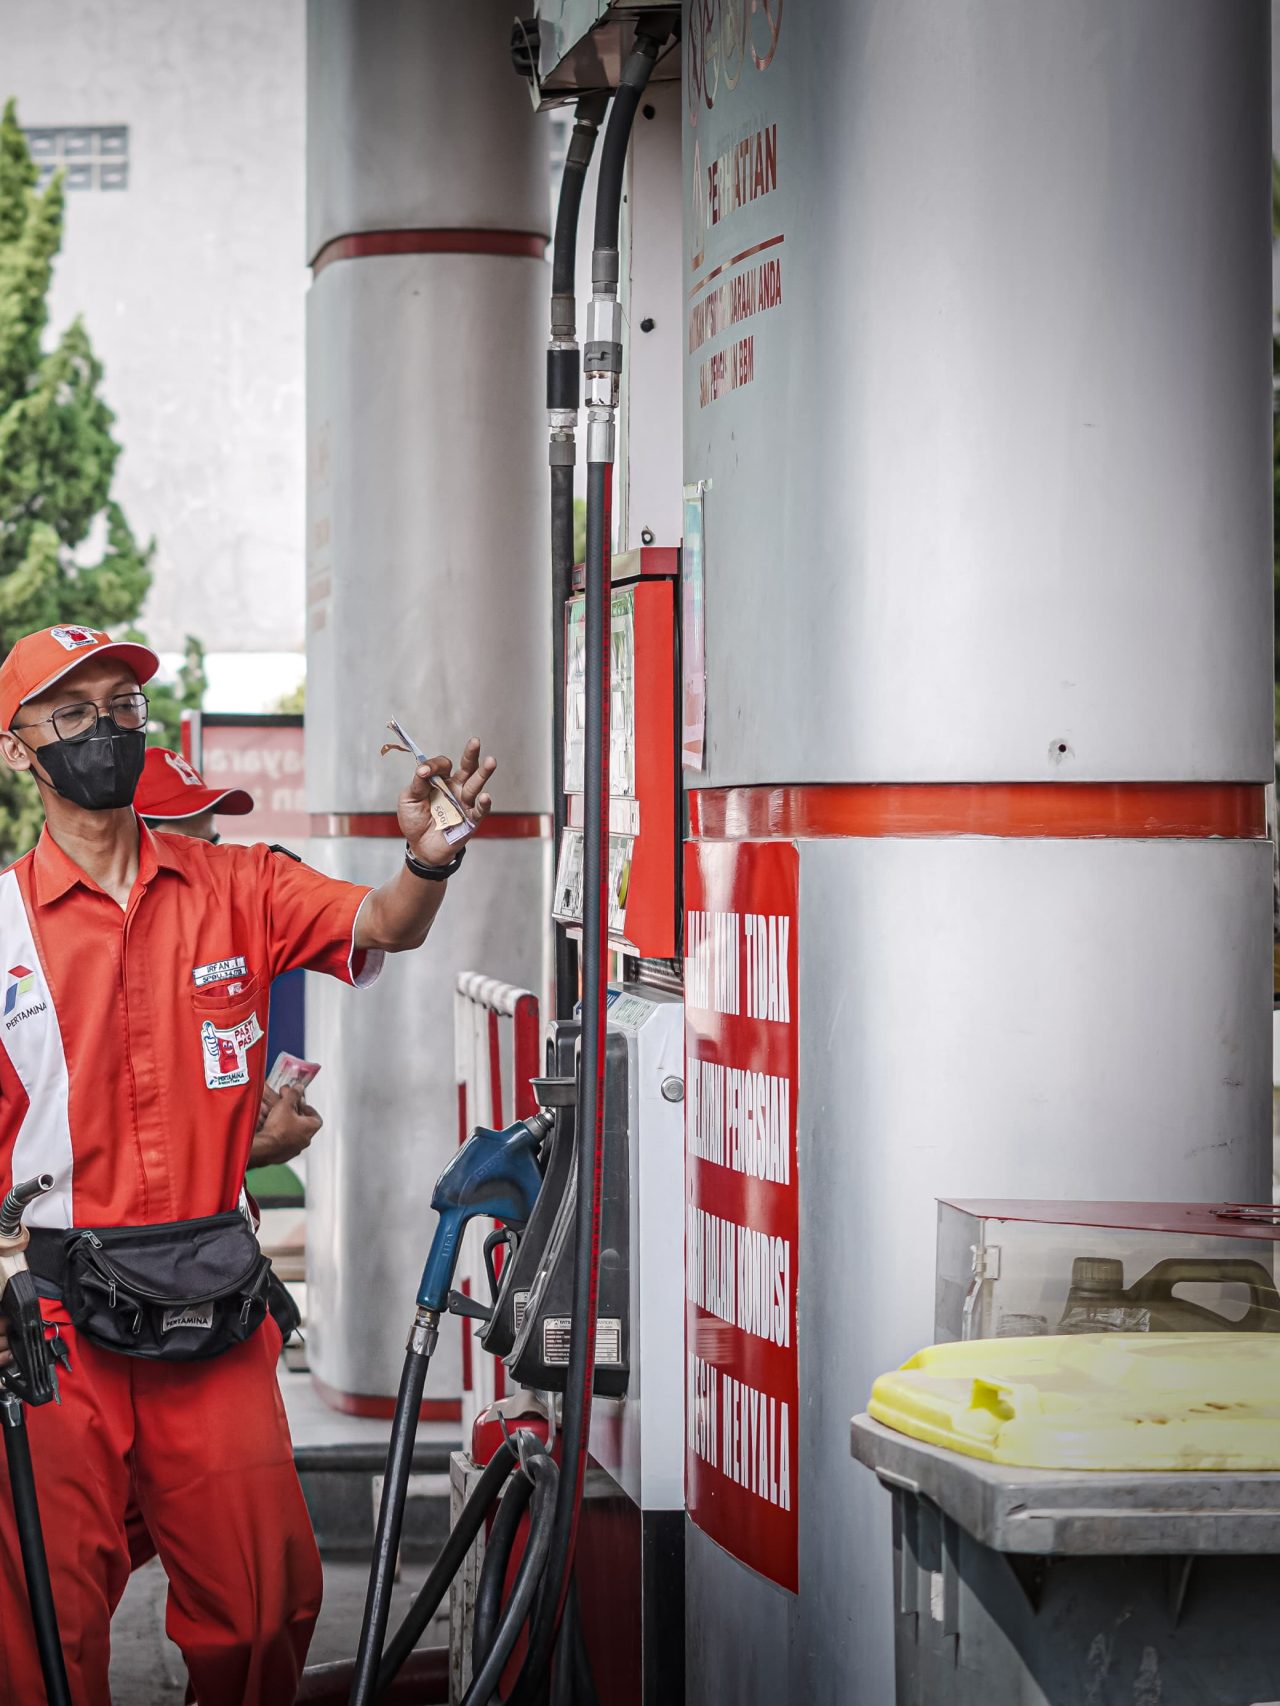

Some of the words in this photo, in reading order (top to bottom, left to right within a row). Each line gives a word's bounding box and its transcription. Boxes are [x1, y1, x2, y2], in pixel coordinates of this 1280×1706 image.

[707, 123, 777, 229] PERHATIAN
[758, 258, 782, 312] ANDA
[739, 334, 754, 387] BBM
[5, 1001, 48, 1031] PERTAMINA
[745, 913, 790, 1024] TIDAK
[688, 1057, 724, 1167] MELAYANI
[726, 1066, 790, 1186] PENGISIAN
[166, 1317, 208, 1327] PERTAMINA
[688, 1203, 704, 1309] BBM
[705, 1211, 735, 1326] DALAM
[737, 1224, 790, 1348] KONDISI
[688, 1350, 717, 1469] MESIN
[722, 1372, 791, 1512] MENYALA
